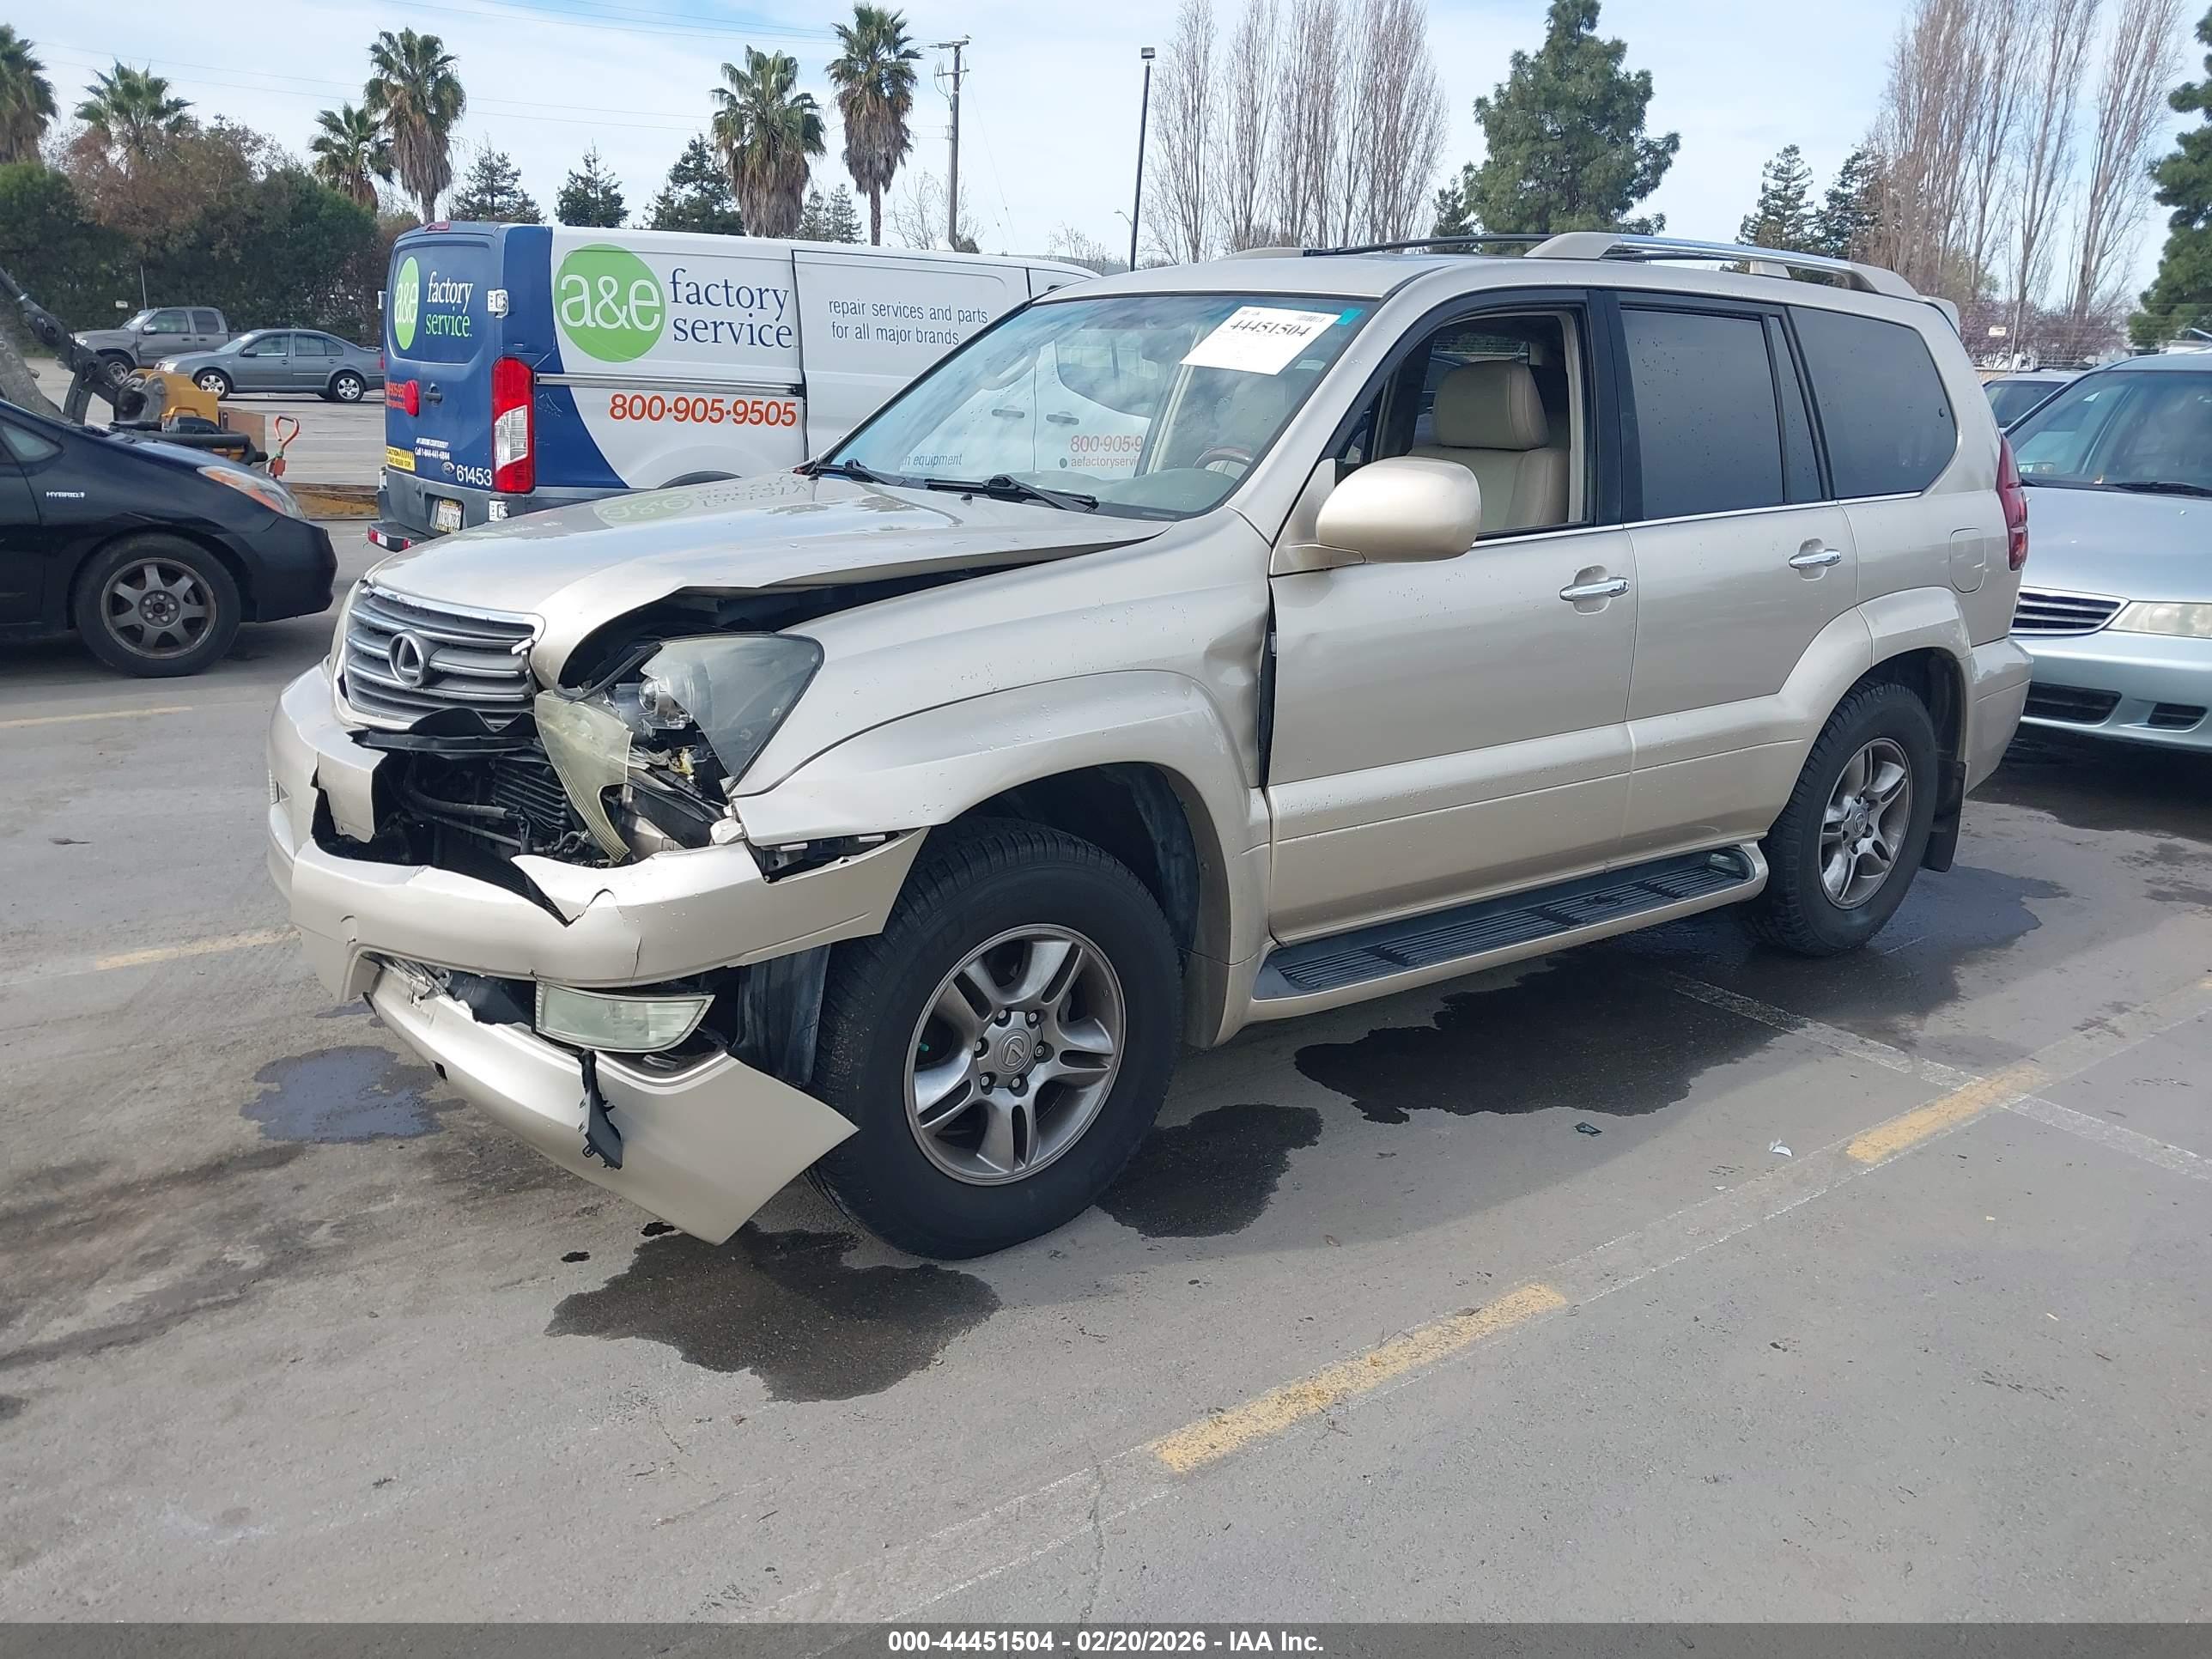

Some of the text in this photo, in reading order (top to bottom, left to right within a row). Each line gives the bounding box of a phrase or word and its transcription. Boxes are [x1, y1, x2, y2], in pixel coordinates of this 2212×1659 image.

[396, 282, 417, 324] a&e
[427, 270, 474, 313] factory
[561, 274, 660, 331] a&e
[669, 268, 789, 322] factory
[829, 299, 988, 325] repair services and parts
[673, 313, 793, 348] service
[832, 321, 959, 345] for all major brands
[1230, 319, 1312, 337] 44451504
[1070, 434, 1143, 453] 800·905·9
[913, 453, 963, 467] equipment
[1071, 456, 1137, 468] aefactoryservi
[456, 465, 492, 487] 61453
